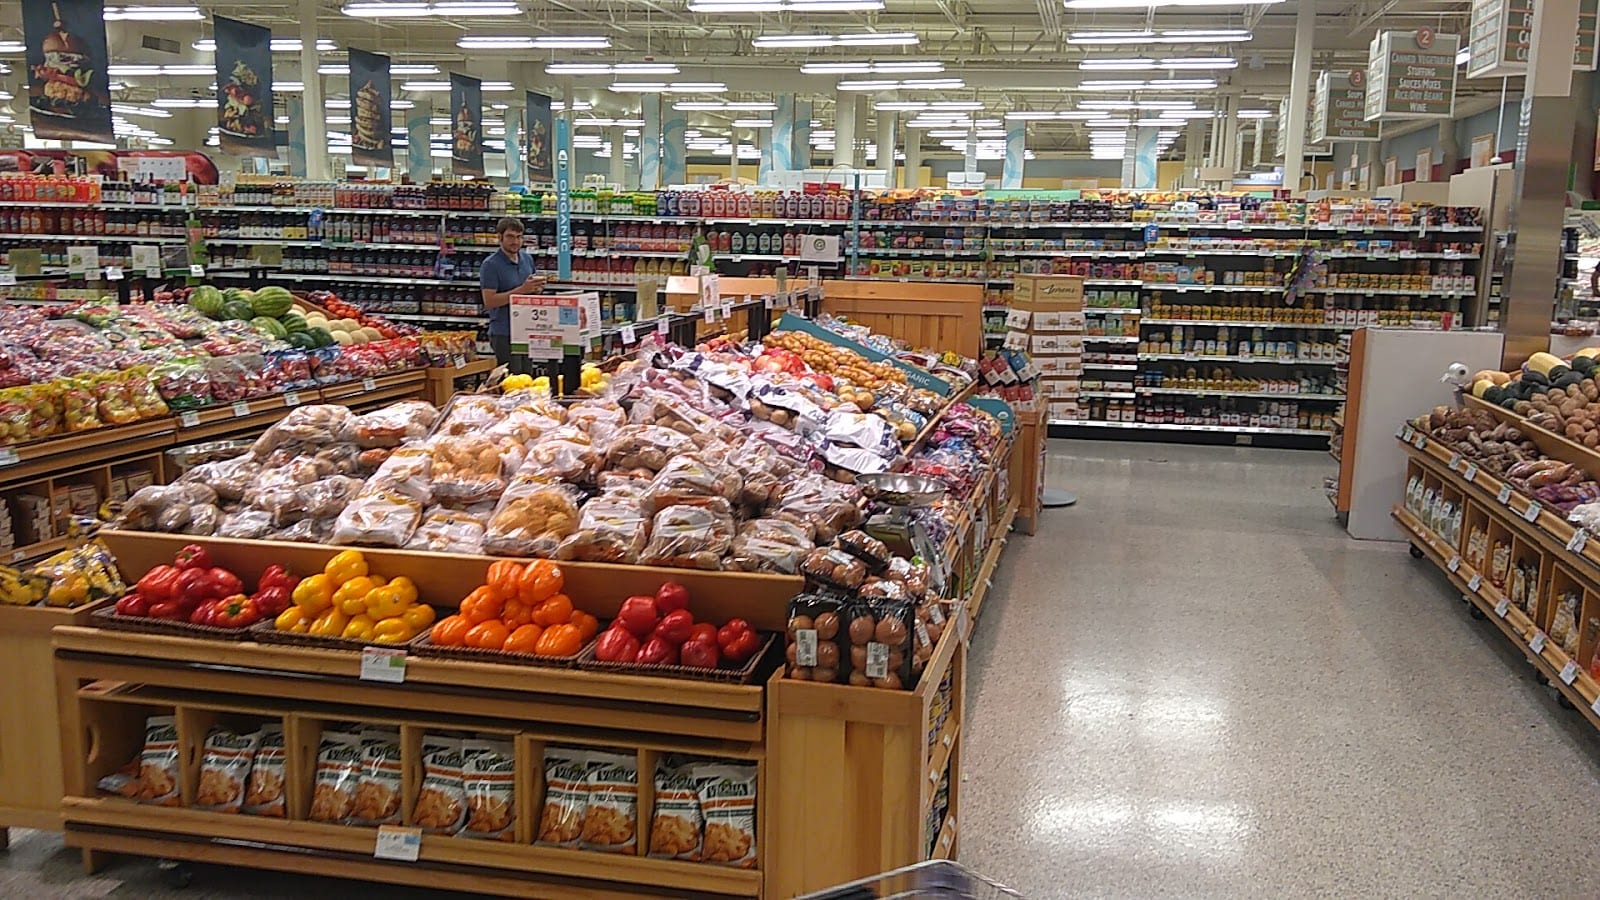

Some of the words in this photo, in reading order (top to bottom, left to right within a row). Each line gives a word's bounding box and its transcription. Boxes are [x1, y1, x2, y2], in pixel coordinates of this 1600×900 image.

[1421, 31, 1429, 44] 2
[1354, 71, 1361, 82] 3
[559, 180, 568, 253] ORGANIC
[531, 309, 539, 321] 3
